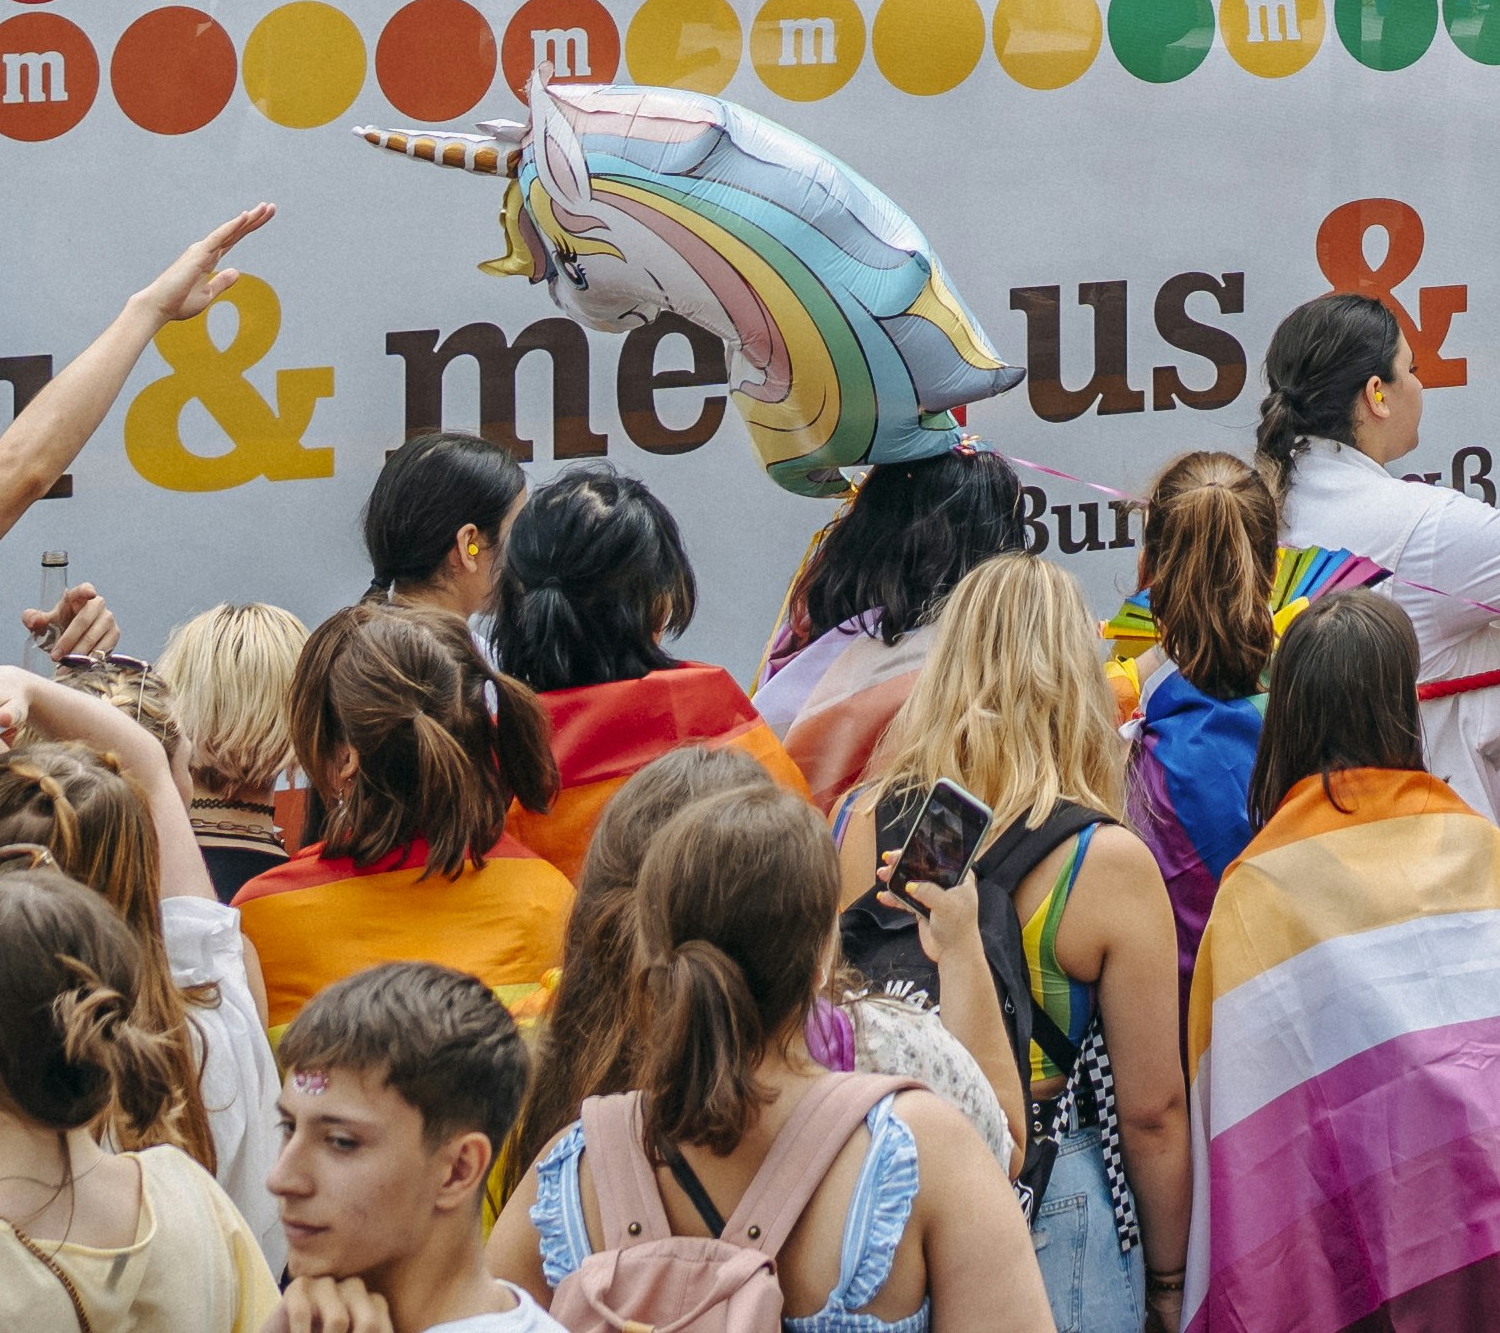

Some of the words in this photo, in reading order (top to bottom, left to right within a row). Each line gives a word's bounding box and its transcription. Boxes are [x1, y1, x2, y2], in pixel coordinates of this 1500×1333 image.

[2, 51, 68, 103] m
[532, 27, 593, 77] m
[776, 17, 837, 66] m
[124, 271, 335, 493] &
[385, 313, 728, 461] me
[1009, 272, 1248, 424] us
[1316, 197, 1468, 388] &
